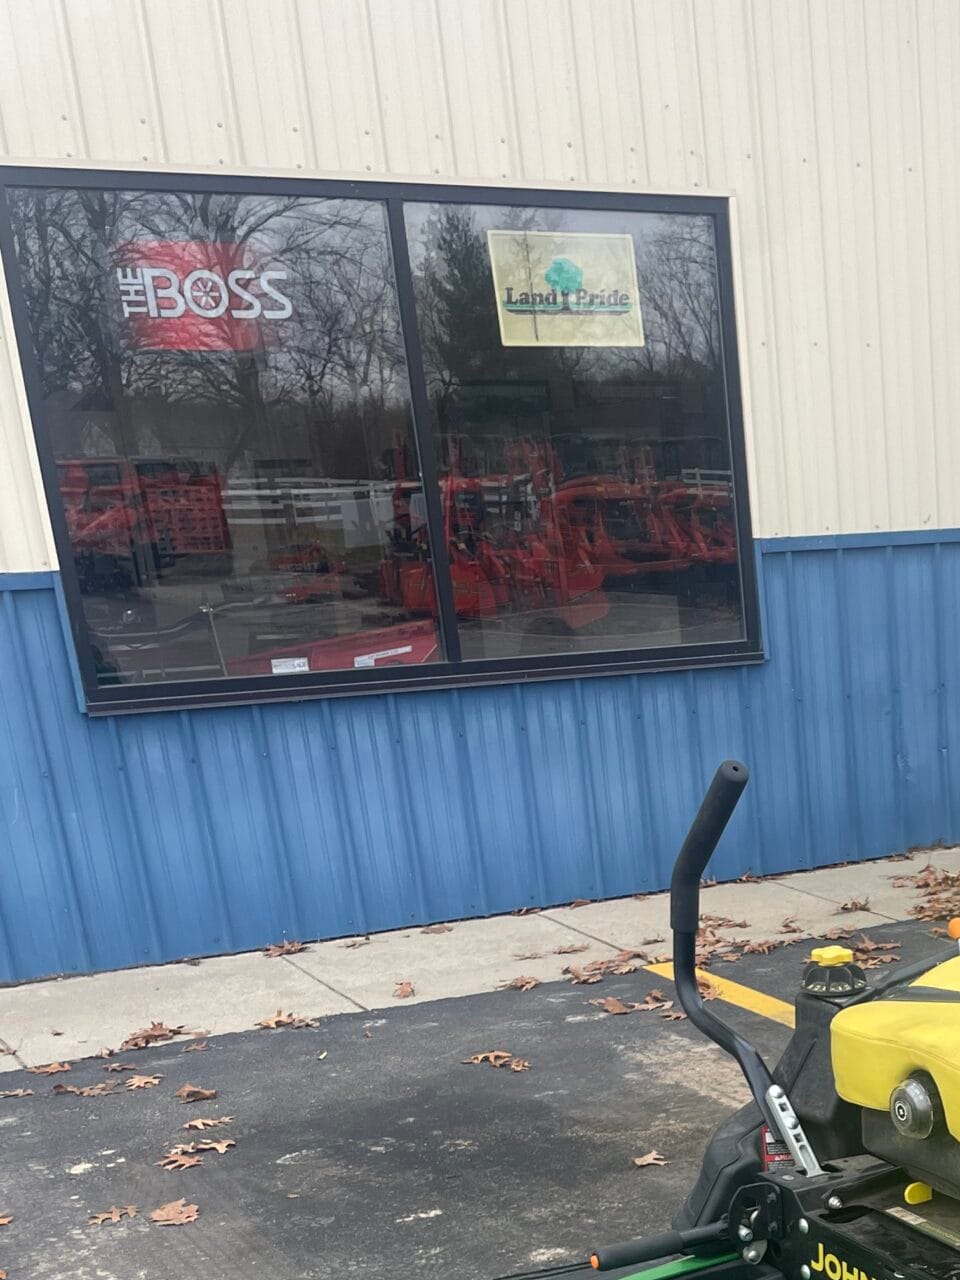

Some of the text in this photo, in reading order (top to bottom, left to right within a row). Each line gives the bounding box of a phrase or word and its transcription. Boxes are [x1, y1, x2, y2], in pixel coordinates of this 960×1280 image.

[117, 268, 292, 319] THE BOSS
[505, 287, 630, 305] Land Pride
